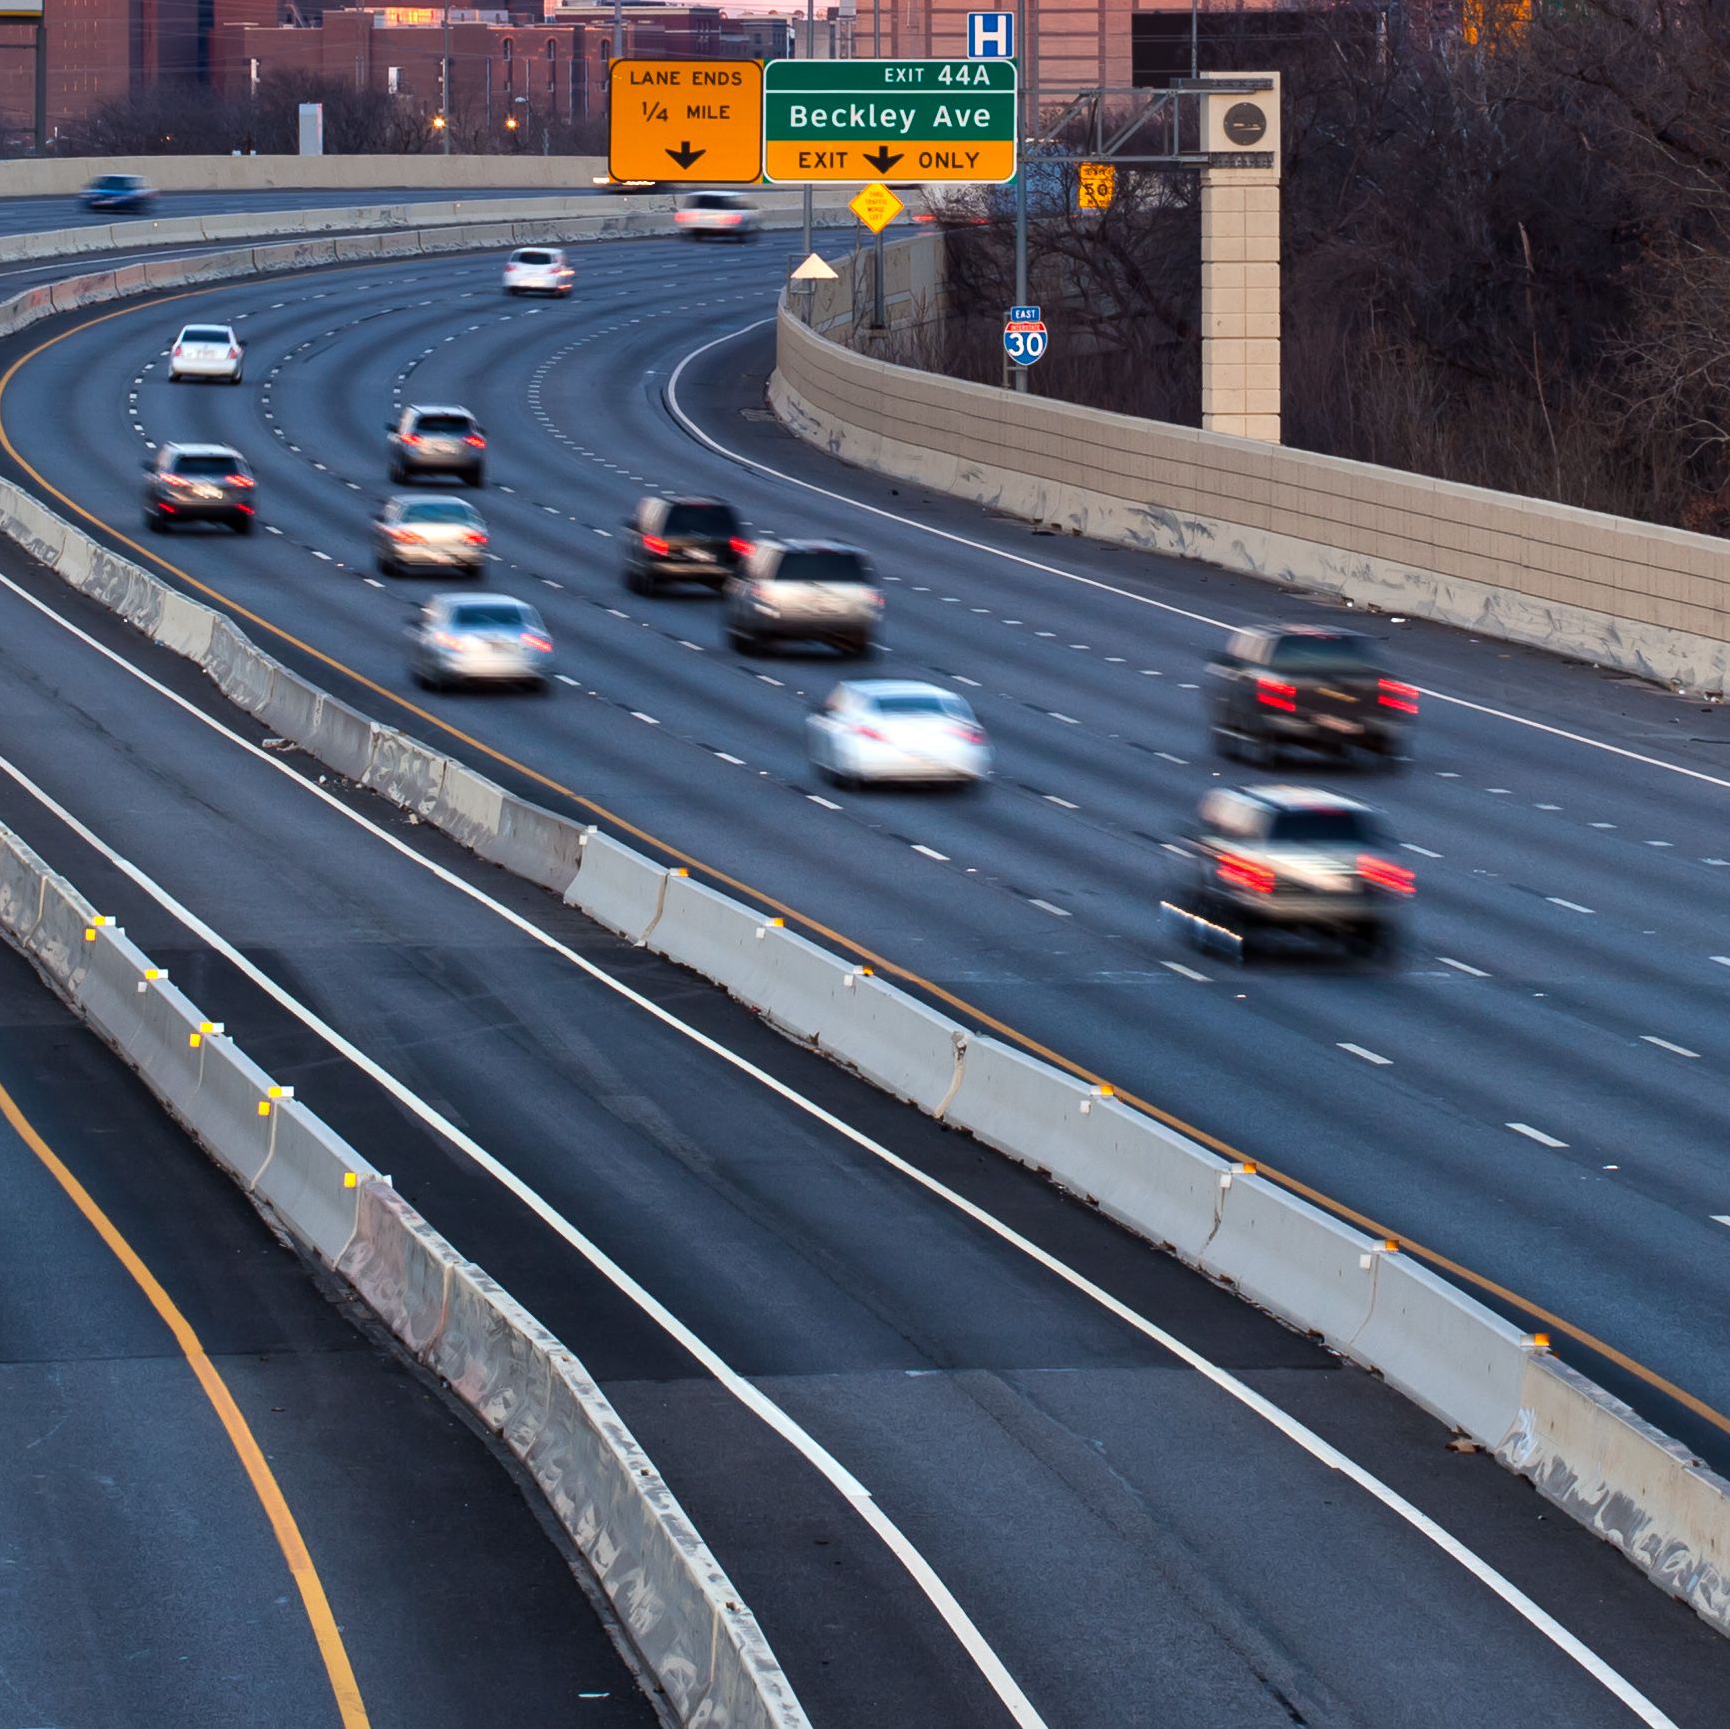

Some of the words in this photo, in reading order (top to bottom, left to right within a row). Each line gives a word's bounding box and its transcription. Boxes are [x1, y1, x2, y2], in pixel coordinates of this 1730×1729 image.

[974, 15, 1007, 56] H
[630, 71, 681, 85] LANE
[692, 71, 742, 86] ENDS
[884, 68, 925, 82] EXIT
[937, 64, 991, 86] 44A
[687, 105, 730, 120] MILE
[790, 103, 916, 134] Beckley
[933, 104, 991, 128] Ave
[799, 151, 848, 169] EXIT
[918, 151, 980, 169] ONLY
[1084, 183, 1108, 196] 50
[1015, 309, 1036, 319] EAST
[1008, 332, 1044, 357] 30
